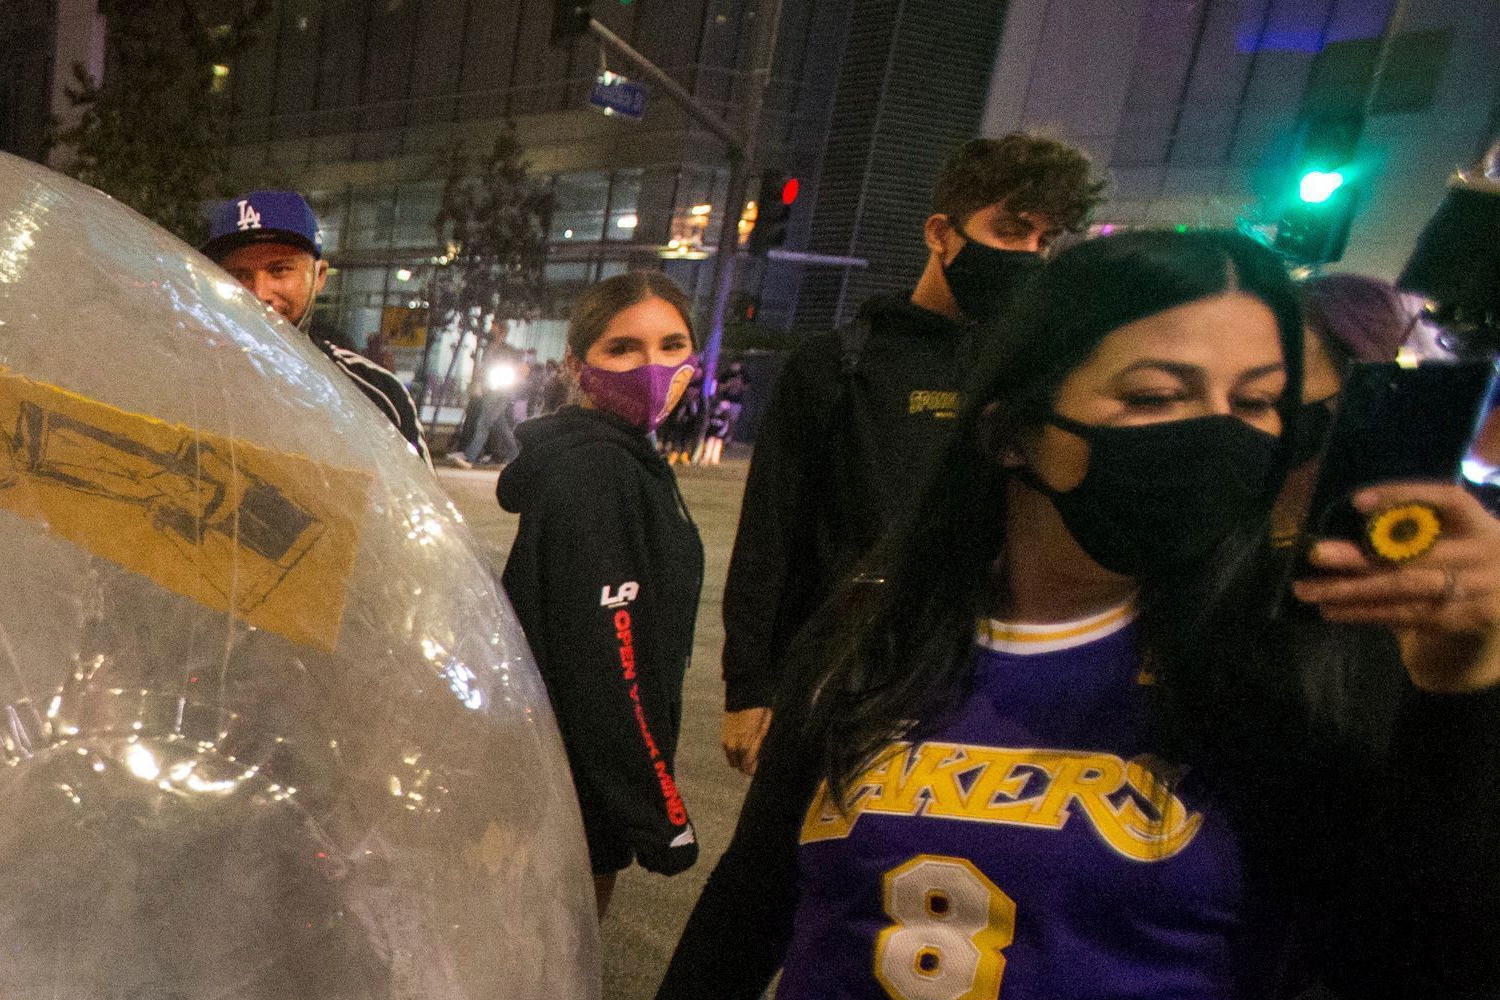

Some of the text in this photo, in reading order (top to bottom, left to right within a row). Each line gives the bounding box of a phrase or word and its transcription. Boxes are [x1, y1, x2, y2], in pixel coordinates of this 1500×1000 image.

[237, 200, 262, 231] LA
[601, 581, 640, 607] LA
[614, 609, 636, 680] OPEN
[654, 760, 687, 827] MIND
